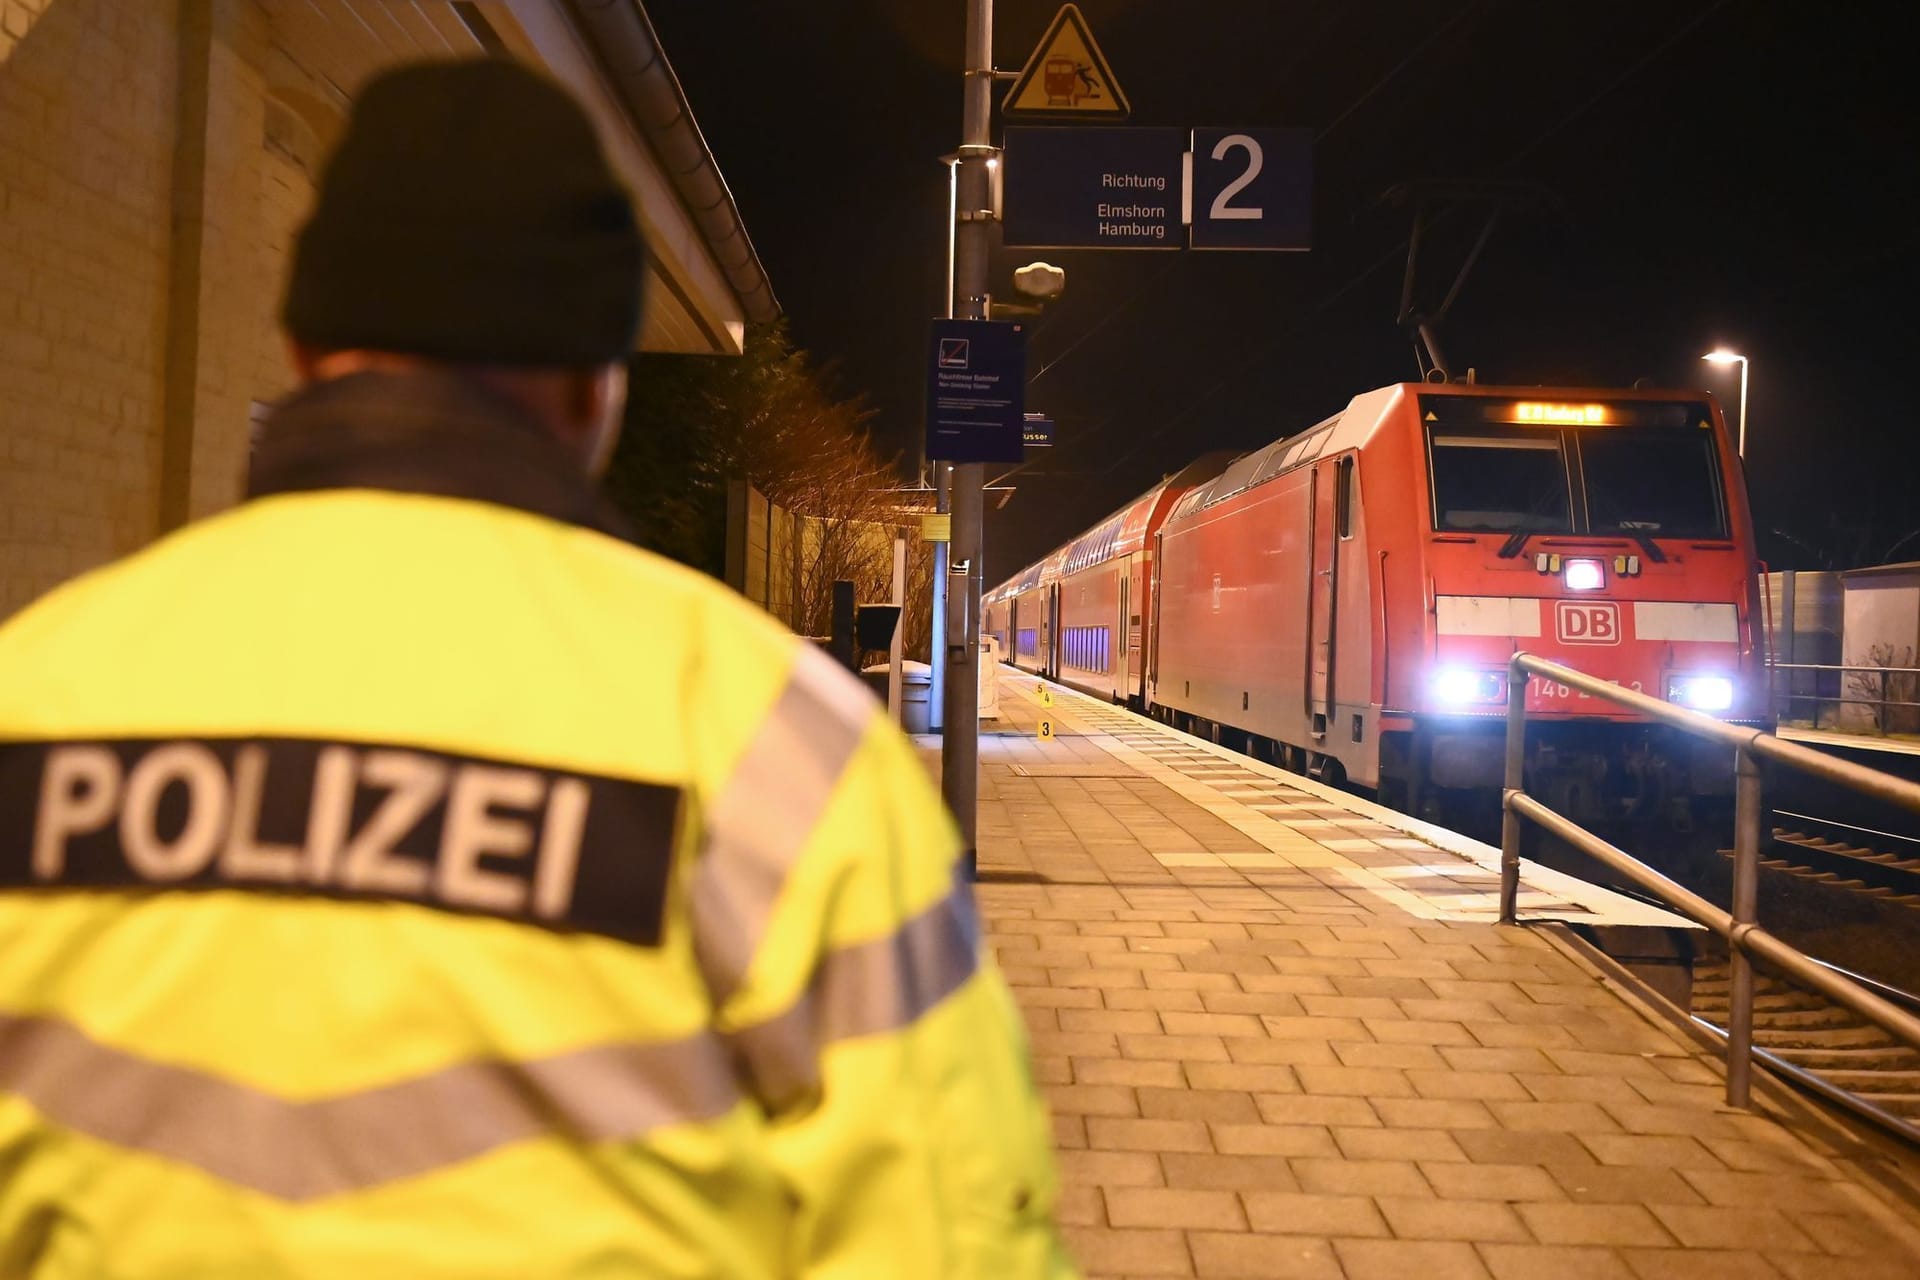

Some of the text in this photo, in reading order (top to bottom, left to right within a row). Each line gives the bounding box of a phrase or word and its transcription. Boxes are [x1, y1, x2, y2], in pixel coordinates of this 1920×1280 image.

[1102, 173, 1166, 191] Richtung
[1210, 134, 1264, 219] 2
[1098, 204, 1165, 218] Elmshorn
[1099, 222, 1165, 239] Hamburg
[1564, 608, 1612, 637] DB
[1038, 684, 1043, 693] 5
[1533, 678, 1569, 698] 146
[1044, 693, 1050, 703] 4
[1042, 722, 1049, 736] 3
[32, 743, 590, 918] POLIZEI
